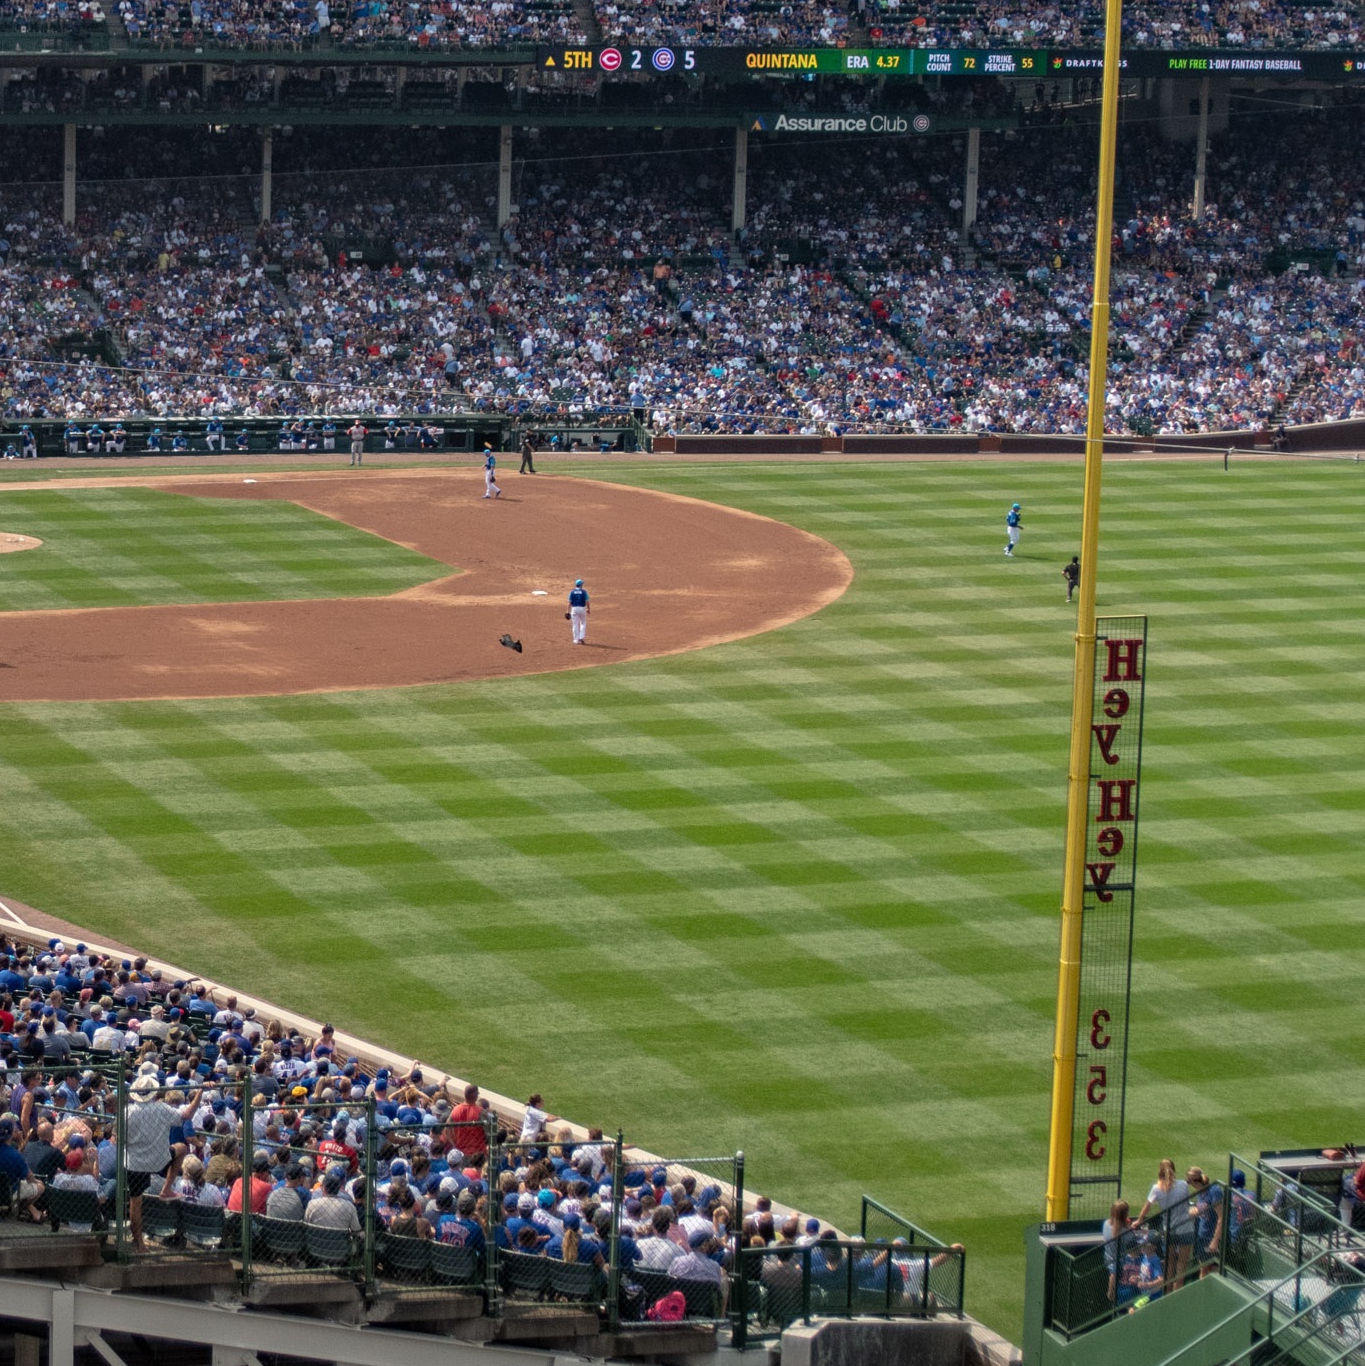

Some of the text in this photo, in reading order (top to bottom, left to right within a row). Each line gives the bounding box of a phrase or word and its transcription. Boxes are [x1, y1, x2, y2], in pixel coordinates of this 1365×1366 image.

[564, 50, 695, 70] 5TH 2 5
[746, 53, 818, 69] QUINTANA
[847, 56, 900, 69] ERA 4.37
[926, 58, 975, 72] COUNT 72
[929, 54, 950, 63] PITCH
[984, 58, 1033, 72] PERCENT 55
[988, 55, 1013, 64] STRIKE
[1169, 59, 1302, 70] PLAY FREE 1-DAY FANTASY BASEBALL
[774, 114, 908, 132] Assurance Club
[1041, 1223, 1056, 1233] 318
